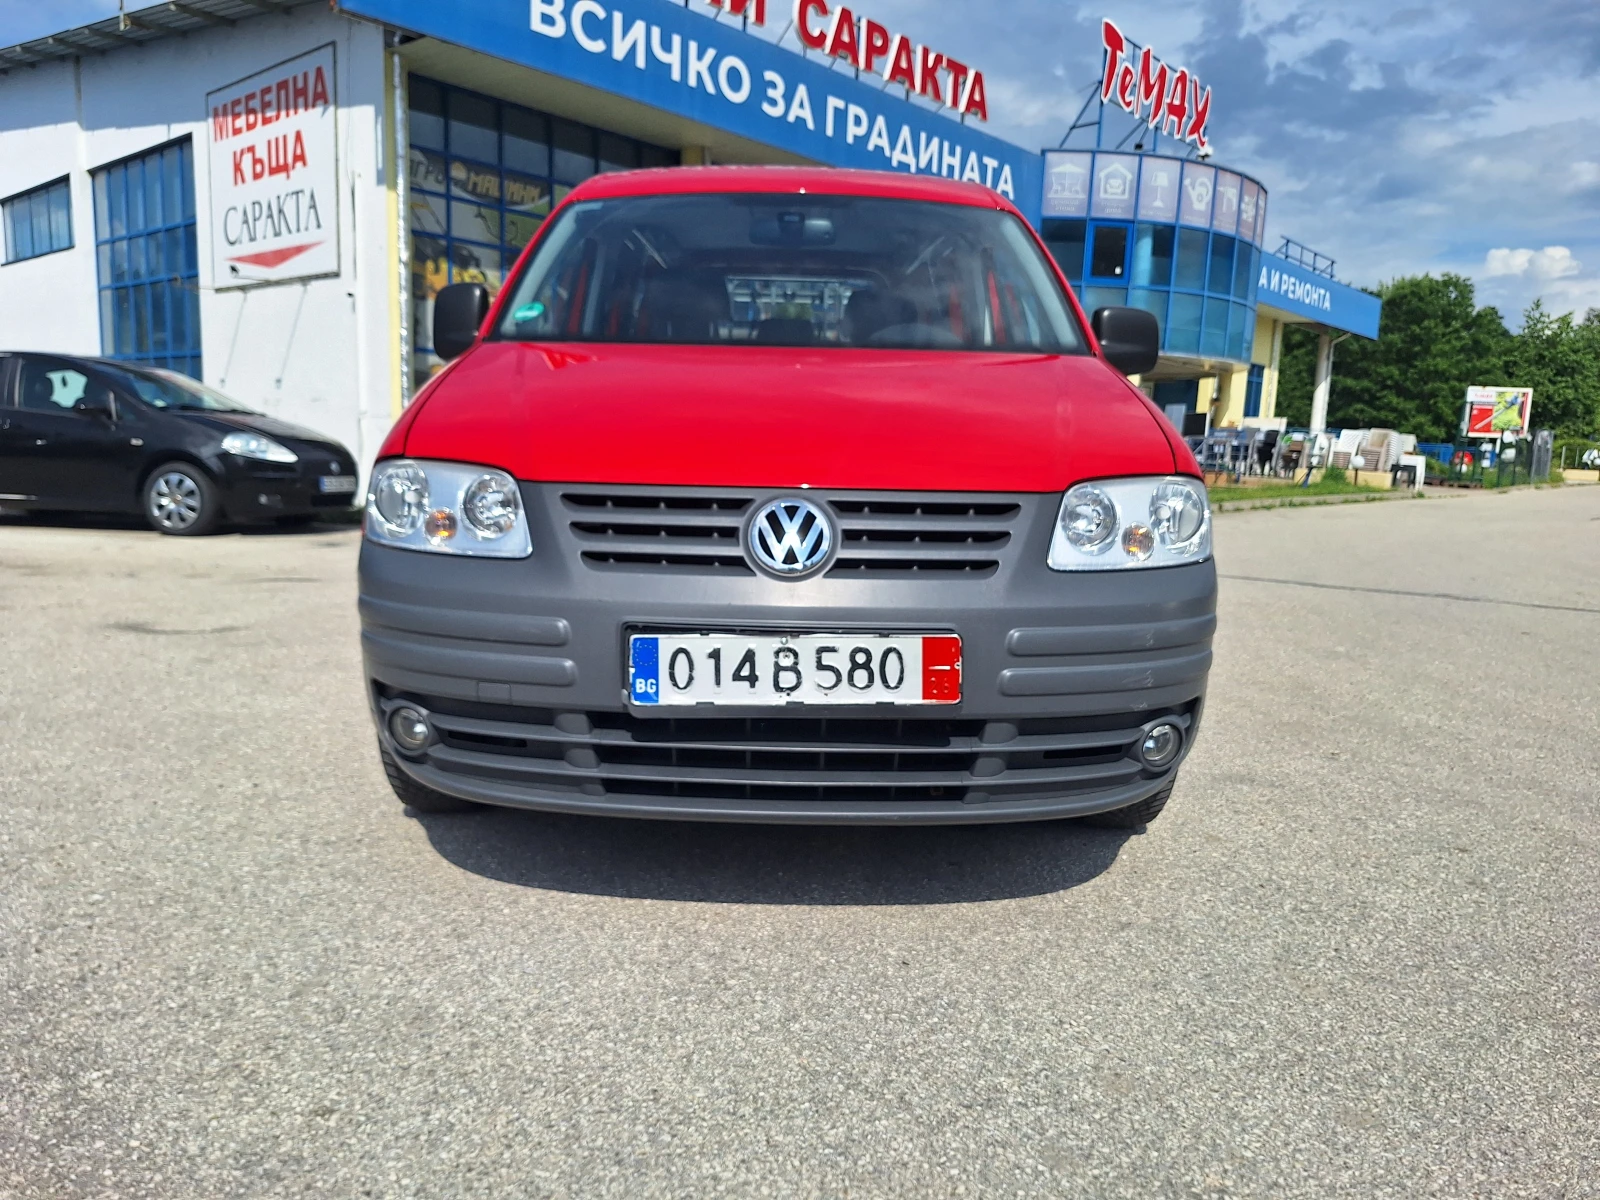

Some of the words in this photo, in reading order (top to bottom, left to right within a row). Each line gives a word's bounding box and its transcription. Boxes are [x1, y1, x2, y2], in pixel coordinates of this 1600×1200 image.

[792, 0, 988, 122] САРАКТА
[212, 64, 331, 143] МЕБЕЛНА
[530, 0, 752, 104] ВСИЧКО
[761, 70, 816, 132] ЗА
[825, 95, 1016, 201] ГРАДИНАТА
[232, 129, 309, 188] КЪЩА
[223, 187, 323, 247] САРАКТА
[1269, 268, 1280, 293] И
[1280, 273, 1331, 312] РЕМОНТА
[635, 678, 657, 694] BG
